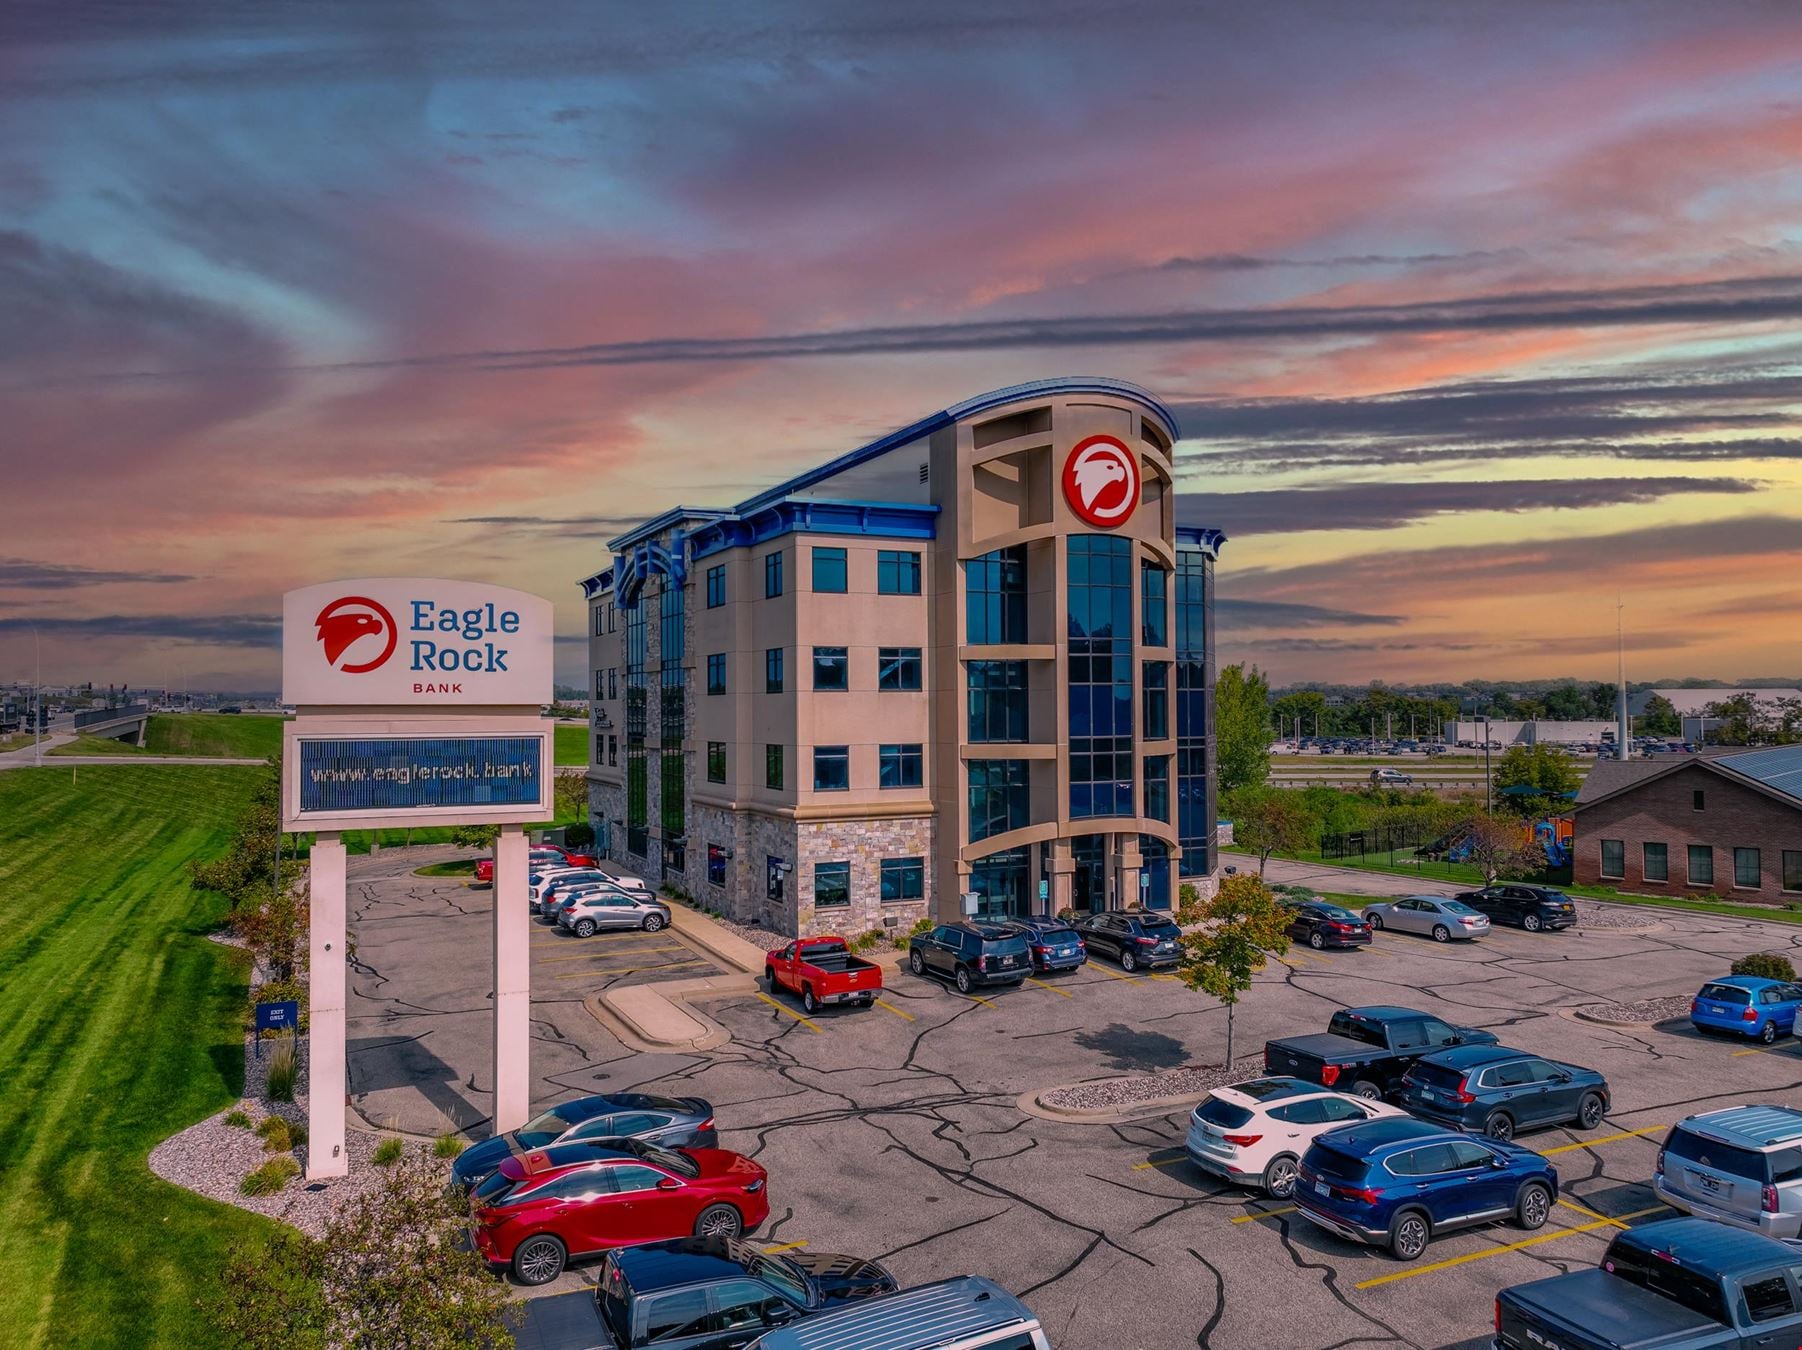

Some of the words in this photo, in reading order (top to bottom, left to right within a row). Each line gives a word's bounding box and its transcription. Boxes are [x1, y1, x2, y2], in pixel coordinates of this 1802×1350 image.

[410, 600, 520, 640] Eagle
[410, 640, 508, 672] Rock
[413, 683, 462, 693] BANK
[1526, 1328, 1566, 1350] RA
